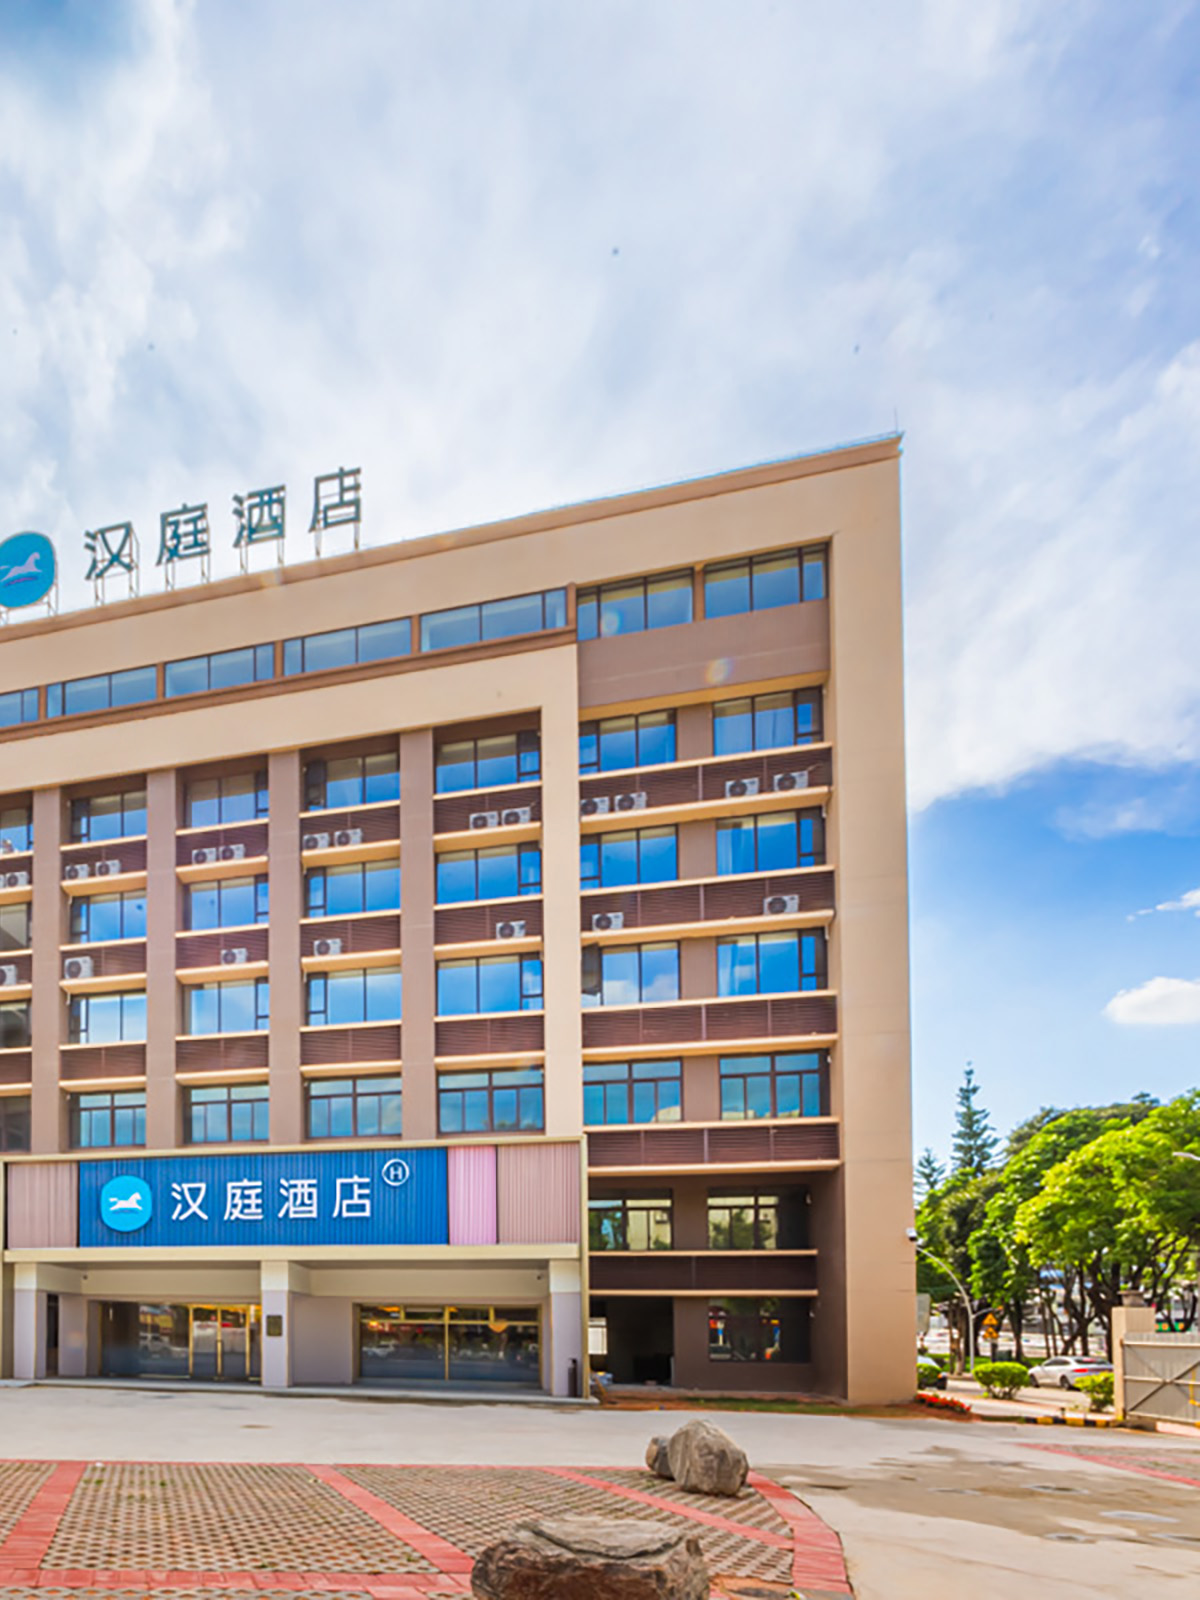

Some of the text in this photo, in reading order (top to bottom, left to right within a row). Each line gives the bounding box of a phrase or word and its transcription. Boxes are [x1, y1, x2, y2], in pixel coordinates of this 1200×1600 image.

[84, 467, 362, 581] 汉庭酒店
[171, 1175, 372, 1222] 汉庭酒店
